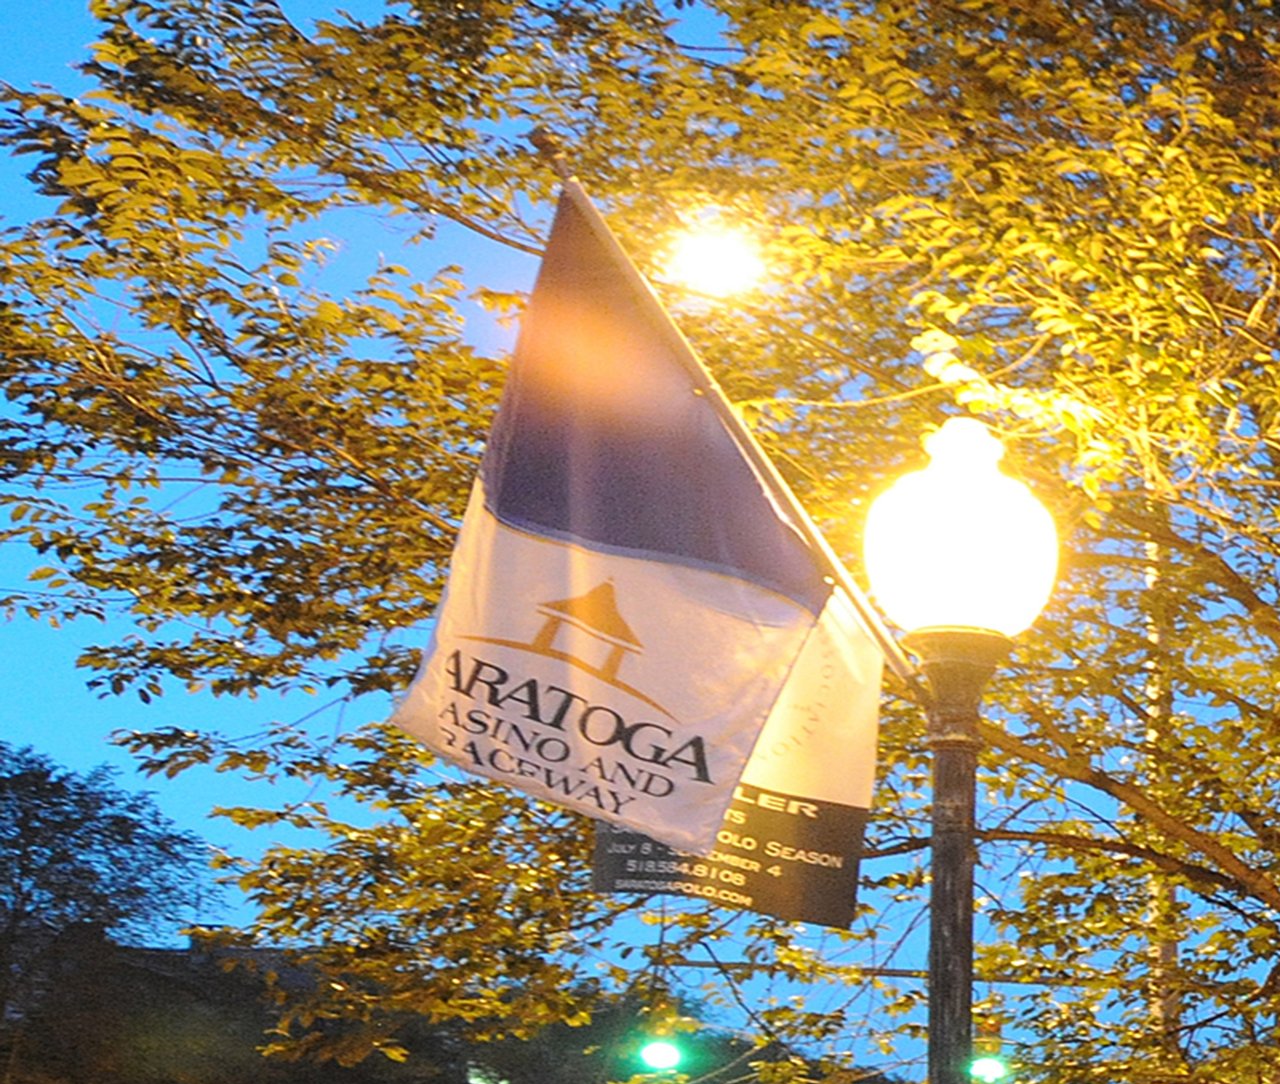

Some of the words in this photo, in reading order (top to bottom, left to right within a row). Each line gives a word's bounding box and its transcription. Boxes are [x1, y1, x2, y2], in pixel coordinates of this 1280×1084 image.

[438, 701, 571, 764] ASINO
[579, 755, 675, 798] AND
[766, 864, 782, 878] 4
